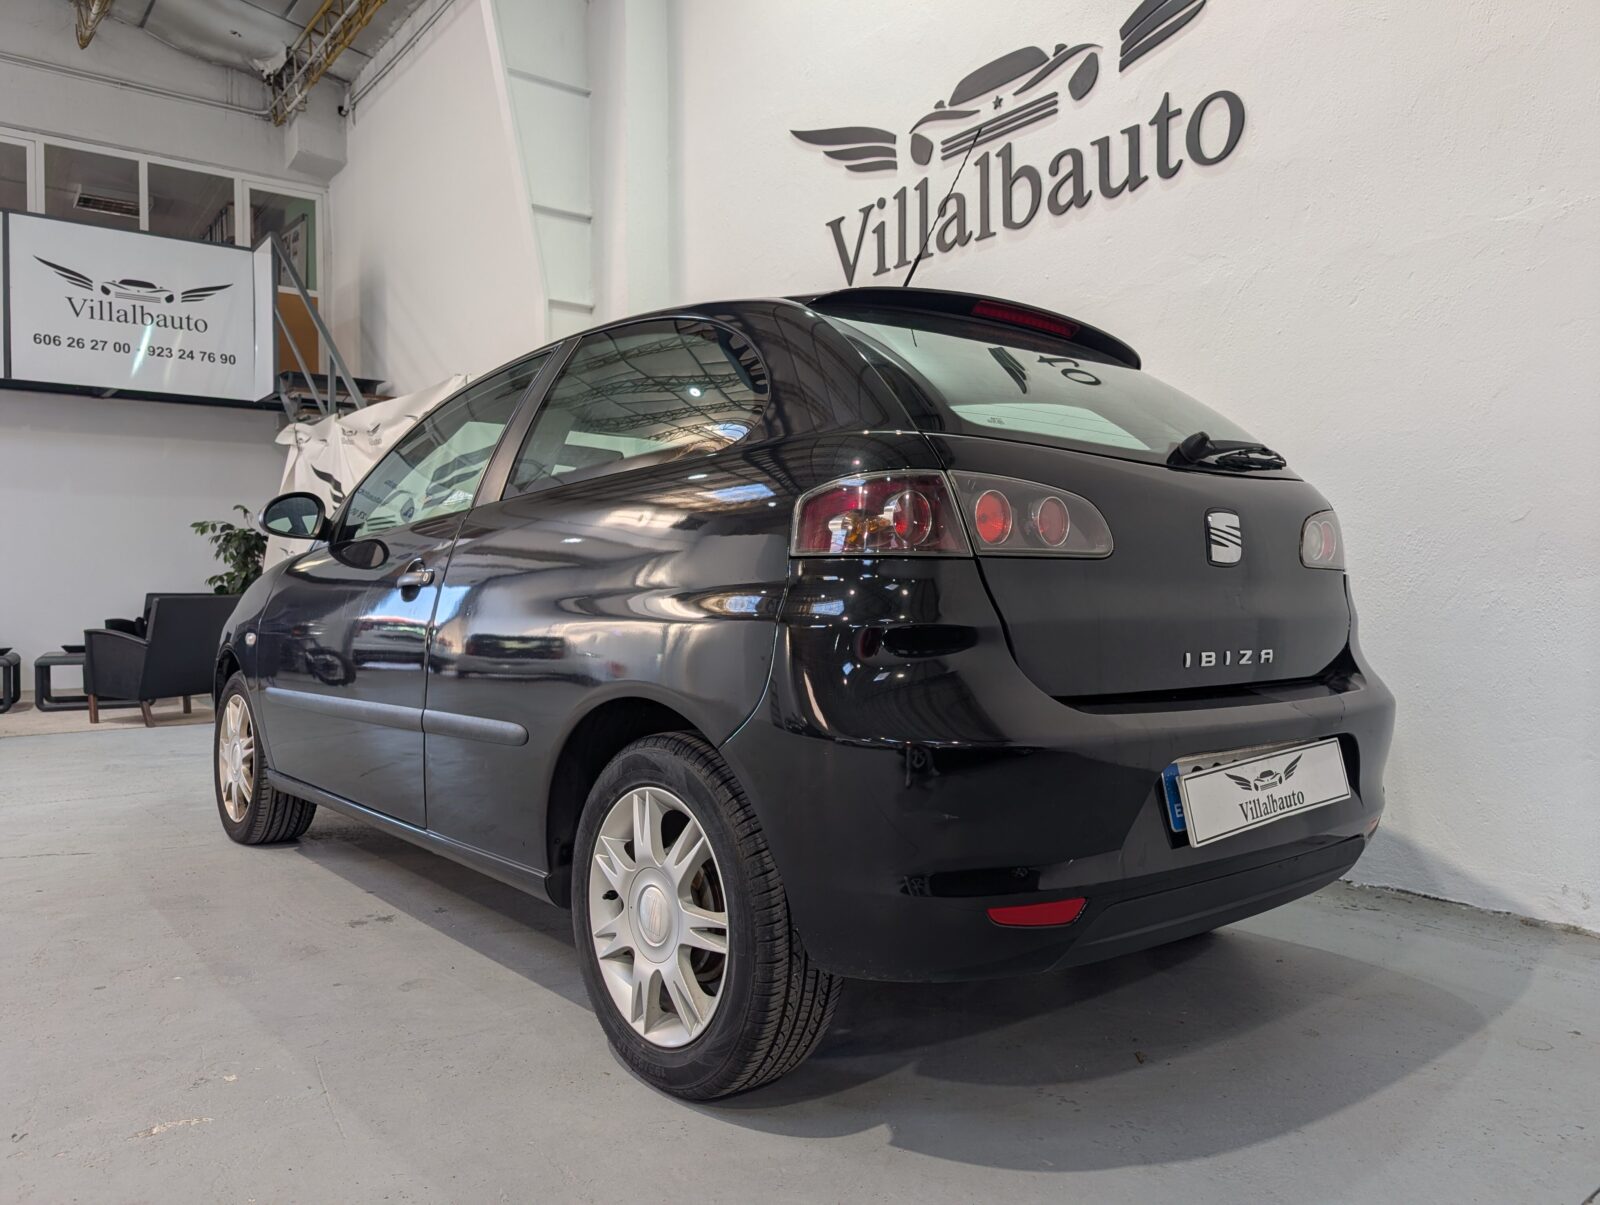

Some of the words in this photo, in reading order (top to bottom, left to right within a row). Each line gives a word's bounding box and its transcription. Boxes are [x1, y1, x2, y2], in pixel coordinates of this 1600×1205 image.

[826, 90, 1246, 287] Villalbauto
[65, 295, 208, 334] Villalbauto
[33, 332, 62, 348] 606
[66, 336, 86, 350] 26
[90, 338, 108, 352] 27
[113, 340, 131, 354] 00
[147, 345, 174, 359] 923
[178, 348, 195, 361] 24
[199, 350, 216, 364] 76
[220, 353, 237, 366] 90
[1183, 649, 1274, 668] IBIZA
[1238, 789, 1305, 823] Villalbauto
